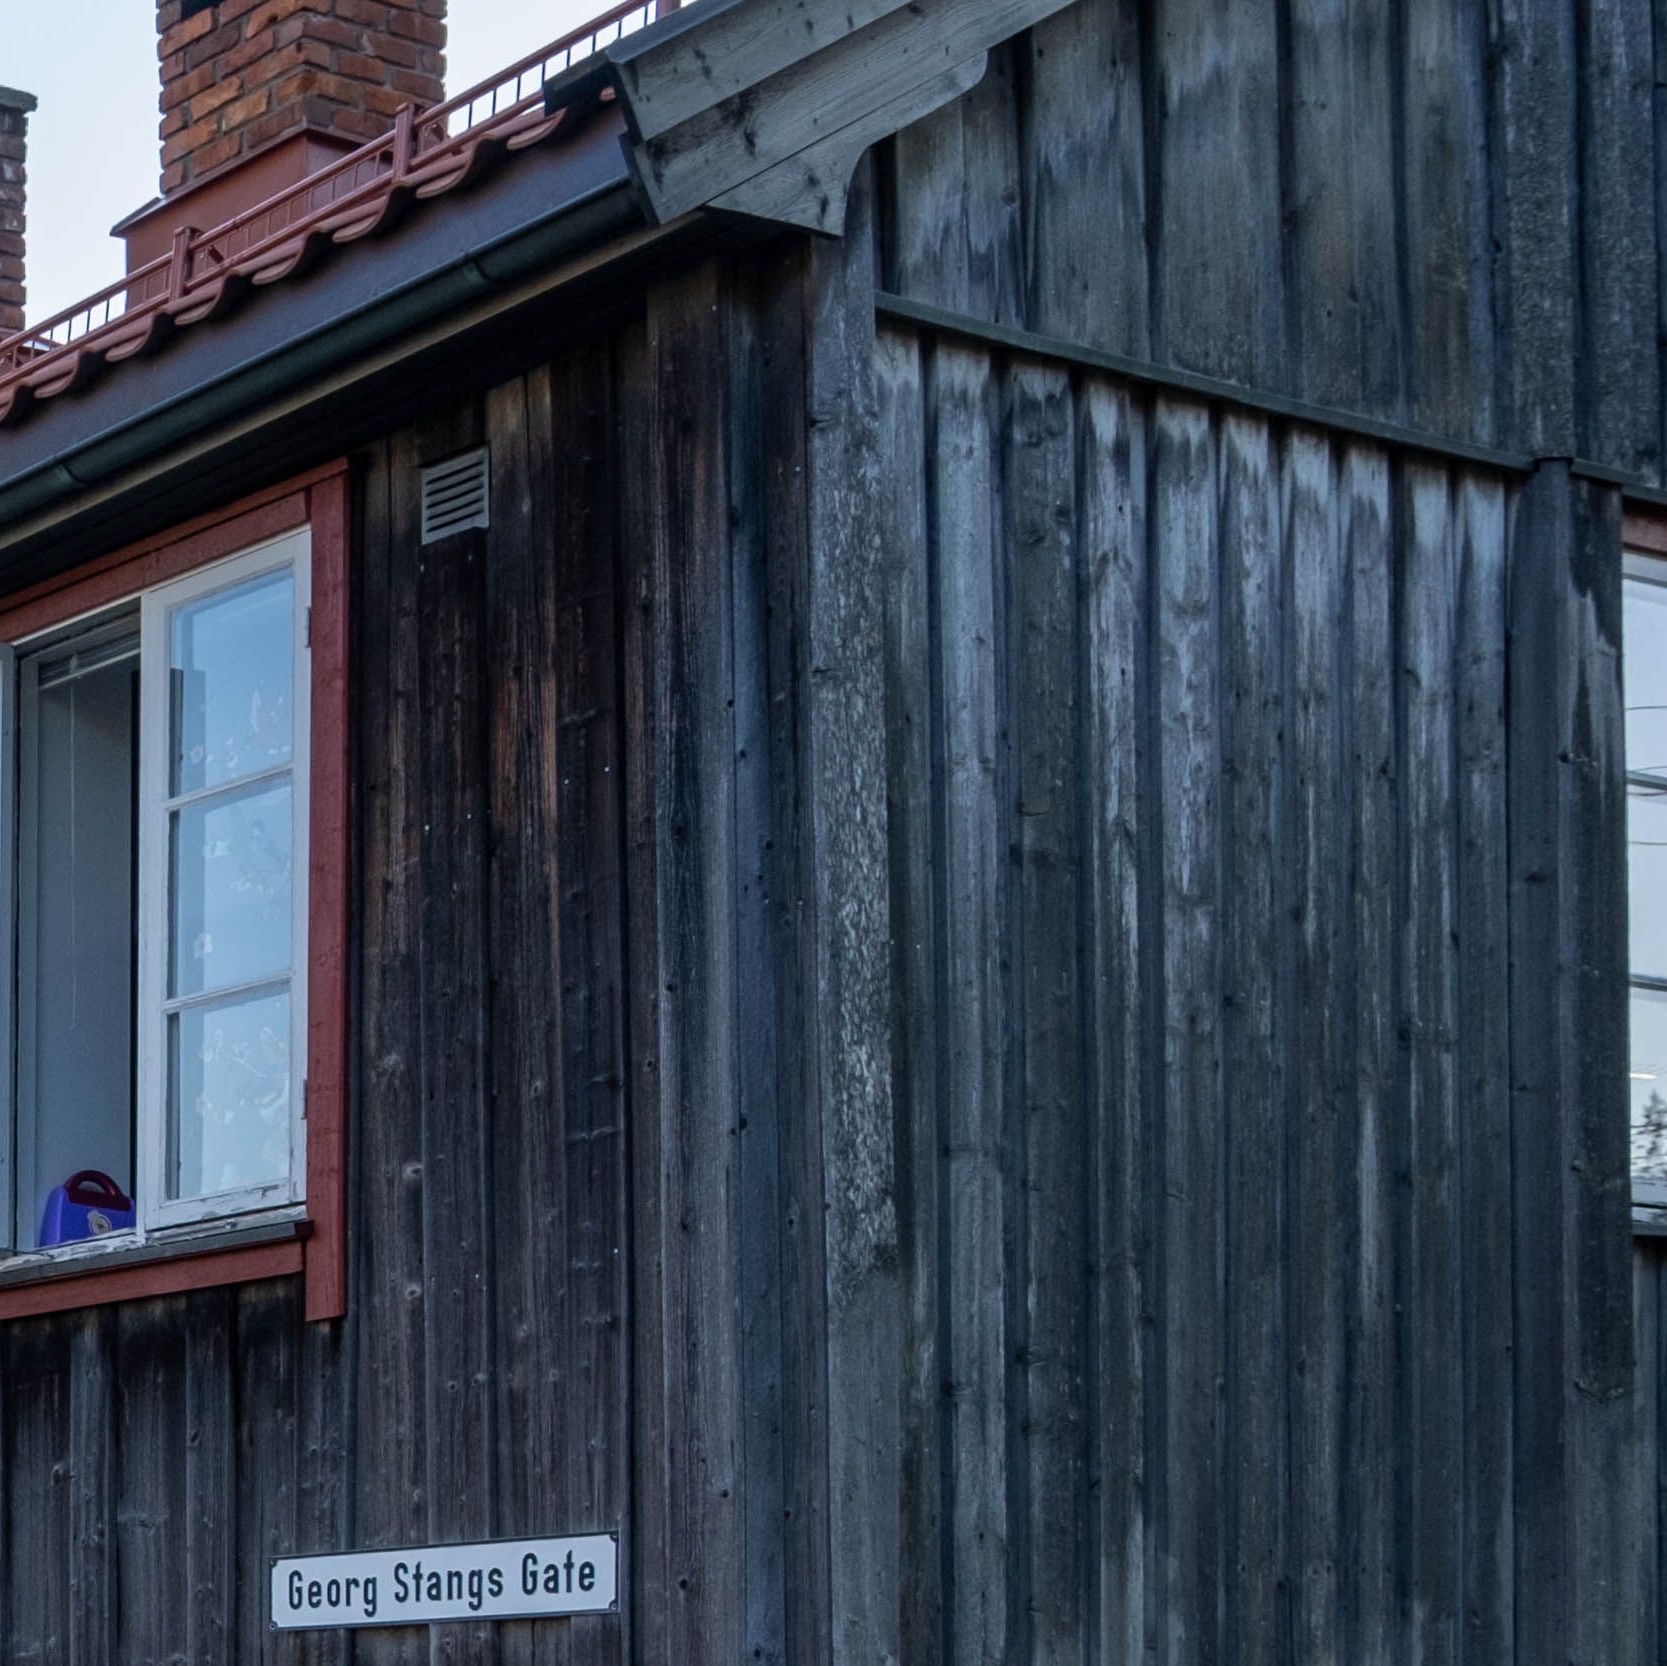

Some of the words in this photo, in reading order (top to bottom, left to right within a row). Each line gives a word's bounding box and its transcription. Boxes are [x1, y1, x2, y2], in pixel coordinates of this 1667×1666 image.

[288, 1569, 377, 1618] Georg
[393, 1562, 504, 1612] Stangs
[521, 1549, 595, 1596] Gate
